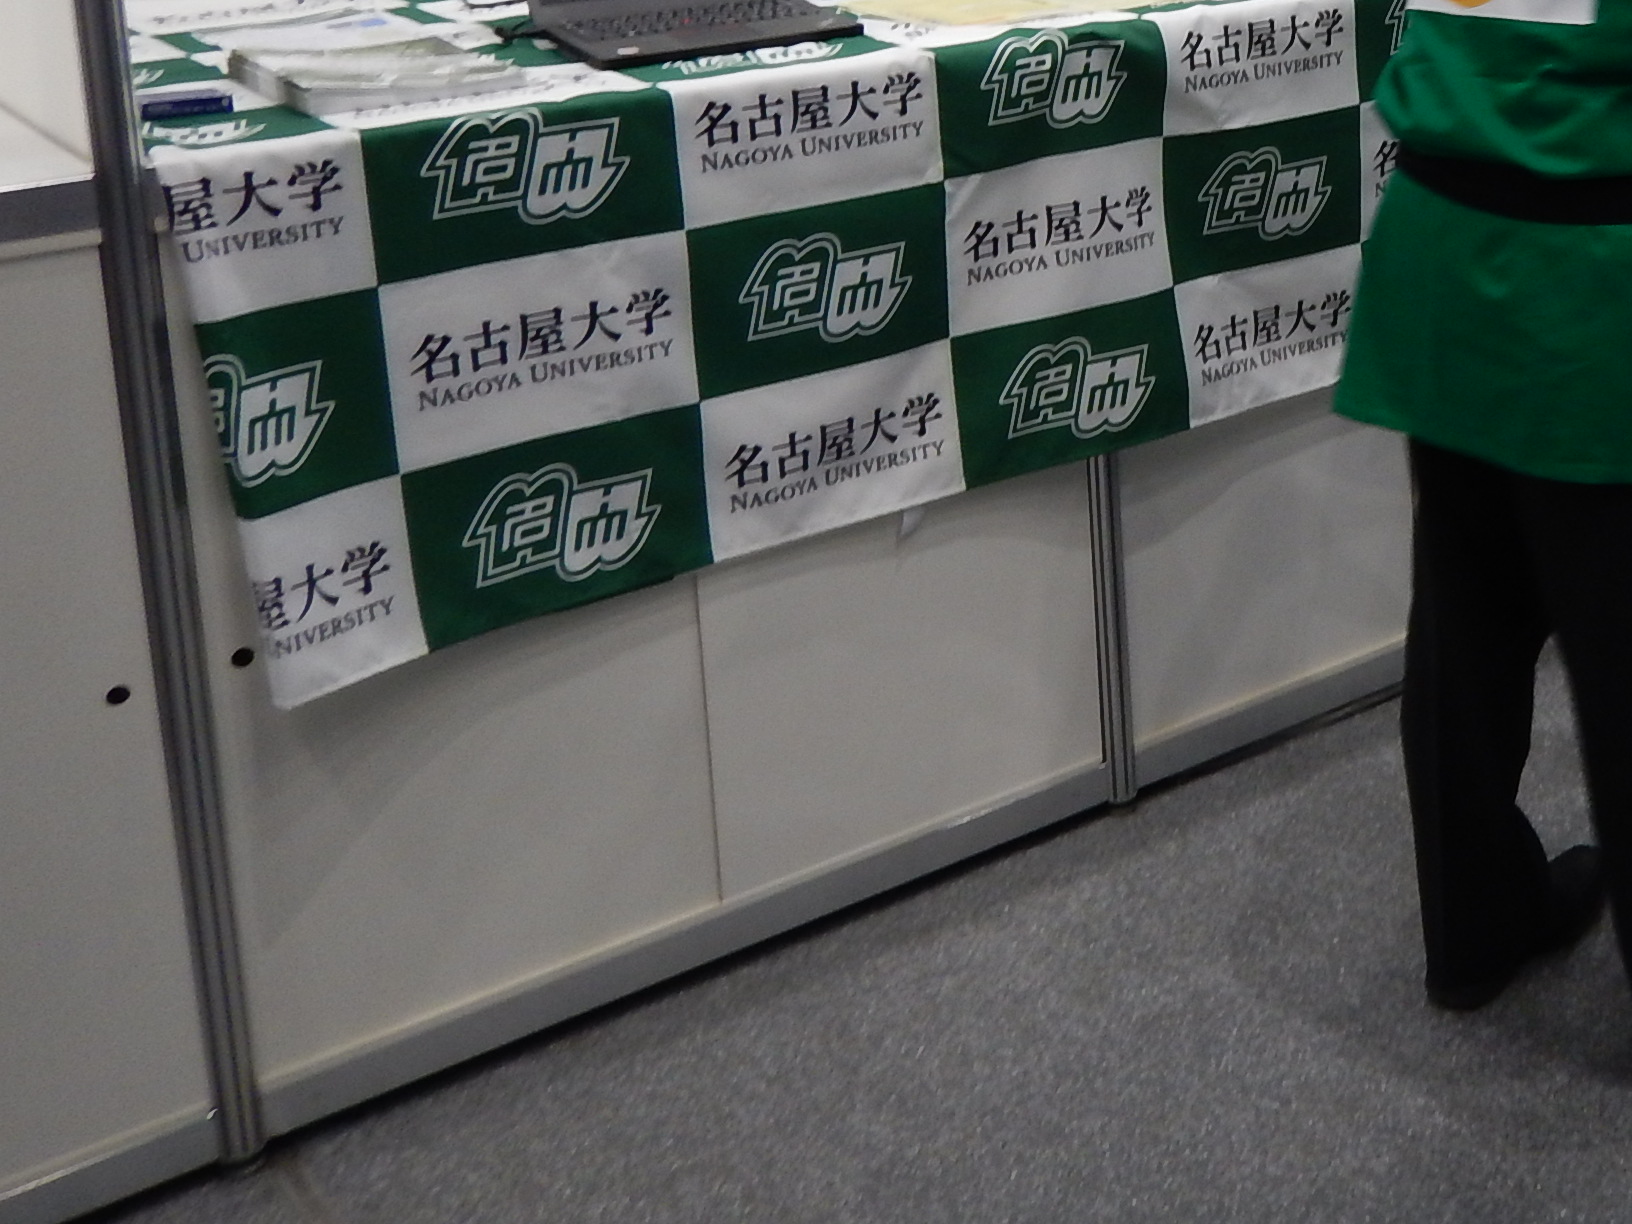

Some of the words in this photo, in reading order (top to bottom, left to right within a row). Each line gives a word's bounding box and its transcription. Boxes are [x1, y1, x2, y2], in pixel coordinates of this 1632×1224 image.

[1181, 8, 1345, 72] 名古屋大学
[1184, 64, 1250, 93] NAGOYA
[1252, 50, 1344, 82] UNIVERSITY
[694, 72, 925, 148] 名古屋大学
[701, 142, 794, 173] NAGOYA
[800, 120, 926, 156] UNIVERSITY
[182, 216, 344, 263] UNIVERSITY
[963, 186, 1154, 263] 名古屋大学
[967, 253, 1048, 286] NAGOYA
[1056, 230, 1156, 269] UNIVERSITY
[410, 288, 673, 385] 名古屋大学
[1193, 289, 1352, 365] 名古屋大学
[418, 371, 524, 412] NAGOYA
[528, 338, 674, 382] UNIVERSITY
[1201, 354, 1257, 387] NAGOYA
[724, 391, 943, 489] 名古屋大学
[729, 477, 822, 514] NAGOYA
[825, 439, 945, 487] UNIVERSITY
